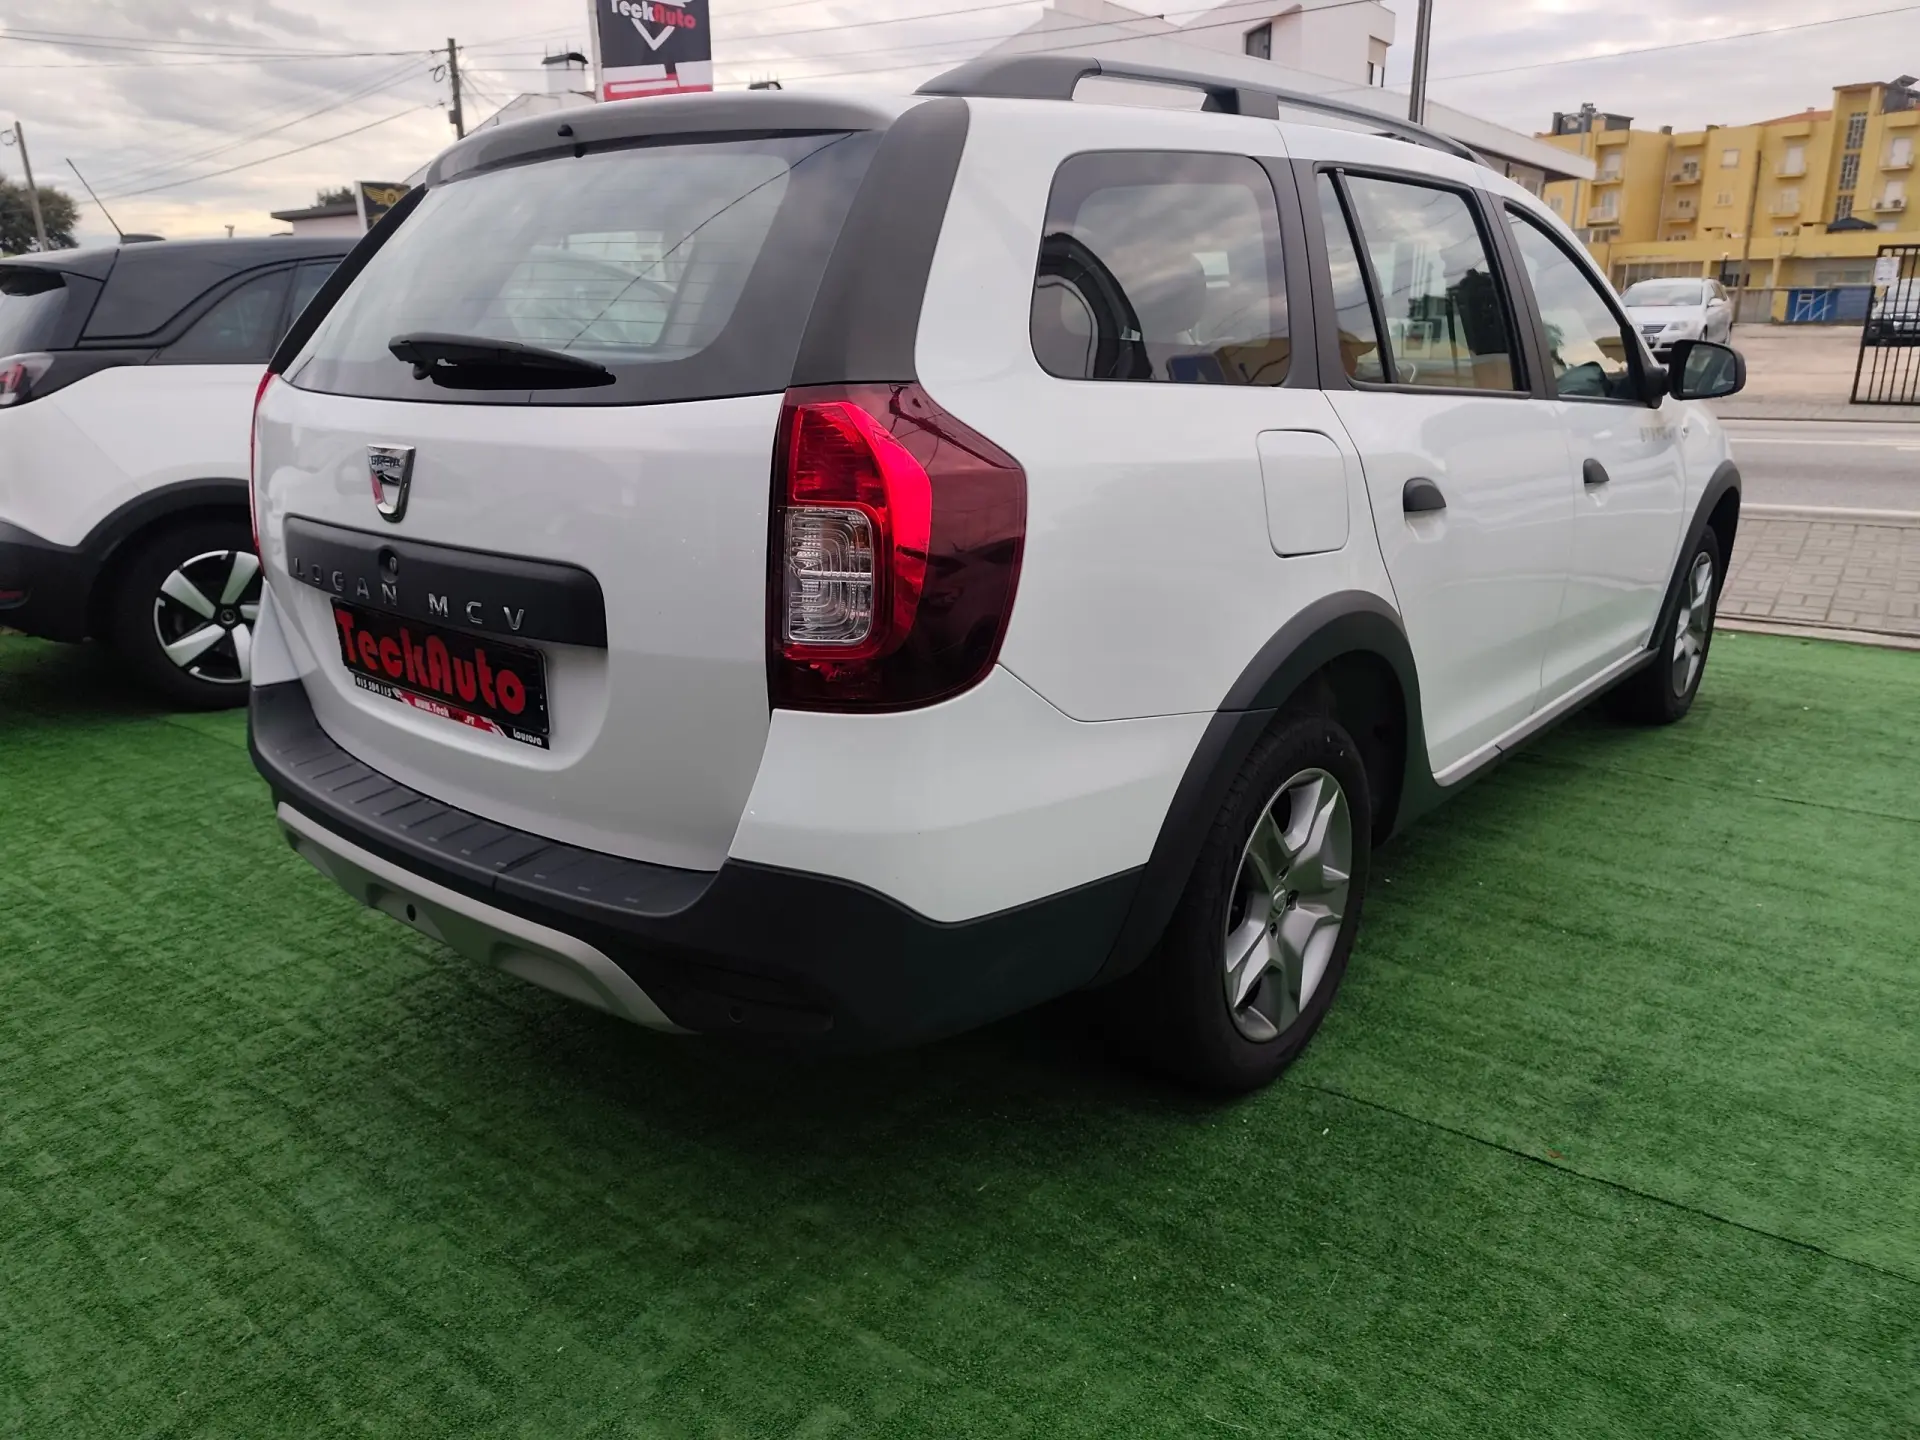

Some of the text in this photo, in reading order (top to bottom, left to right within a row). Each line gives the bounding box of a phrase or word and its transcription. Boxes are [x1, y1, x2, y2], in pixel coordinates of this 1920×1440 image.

[294, 556, 525, 631] LOGAN MCV
[335, 607, 526, 715] TeckAuto
